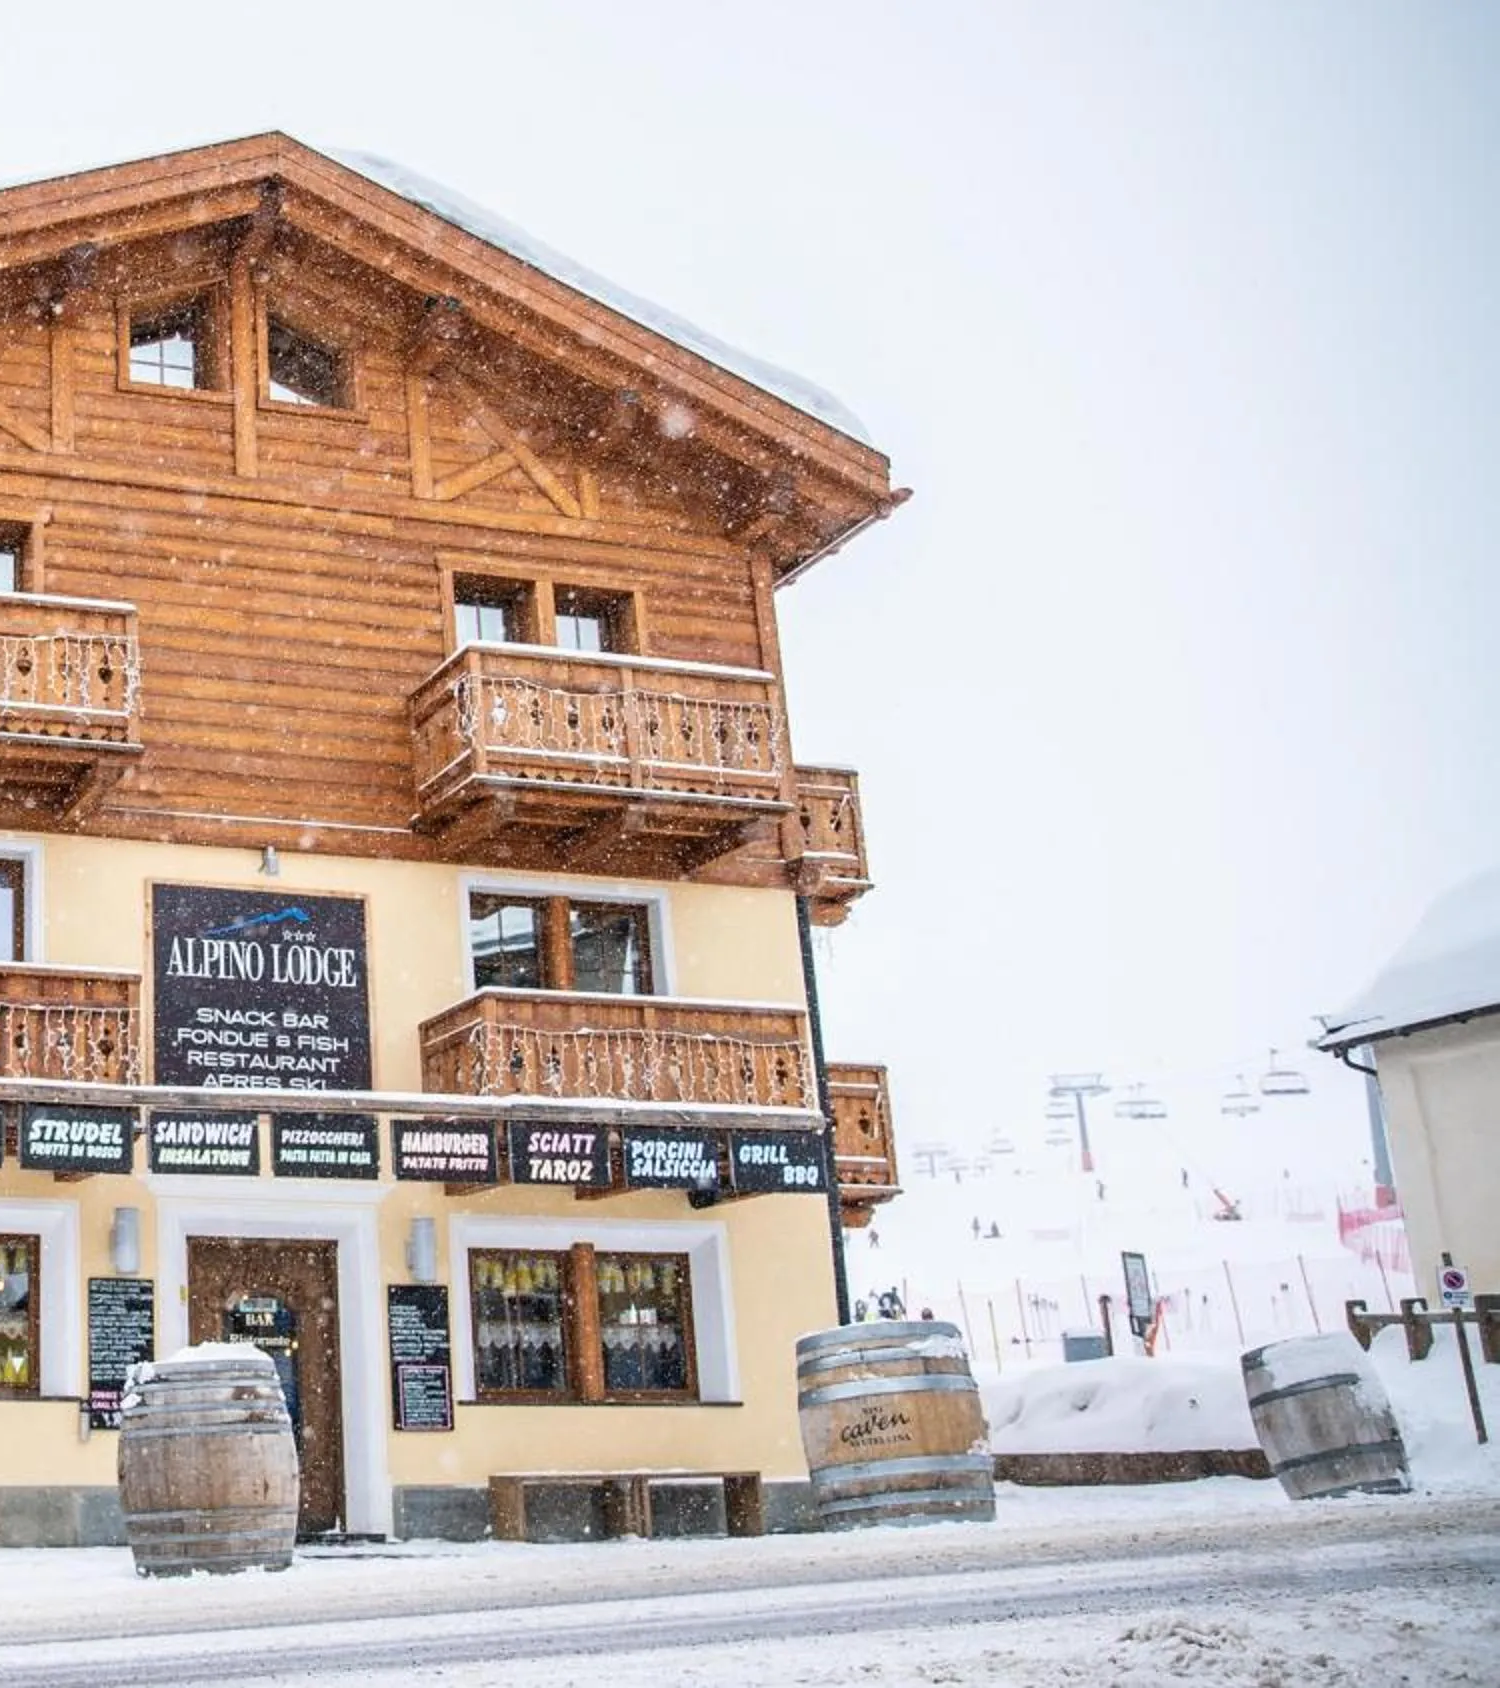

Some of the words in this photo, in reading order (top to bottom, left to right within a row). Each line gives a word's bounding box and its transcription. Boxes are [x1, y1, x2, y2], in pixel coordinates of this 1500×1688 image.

[166, 936, 264, 981] ALPINO
[271, 943, 357, 988] LODGE
[196, 1007, 276, 1027] SNACK
[283, 1012, 329, 1030] BAR
[177, 1028, 269, 1047] FONDUE
[297, 1036, 349, 1053] FISH
[187, 1052, 341, 1073] RESTAURANT
[289, 1077, 327, 1091] SKI
[28, 1119, 124, 1145] STRUDEL
[154, 1120, 253, 1146] SANDWICH
[281, 1129, 366, 1147] PIZZOCCHERI
[527, 1131, 596, 1154] SCIATT
[29, 1141, 69, 1157] FRUTTI
[87, 1145, 123, 1160] BOSCO
[401, 1131, 489, 1157] HAMBURGER
[630, 1140, 704, 1160] PORCINI
[739, 1144, 789, 1165] GRILL
[158, 1147, 252, 1167] INSALATONE
[402, 1156, 447, 1170] PATATE
[449, 1157, 489, 1172] FRITTE
[529, 1158, 594, 1182] TAROZ
[631, 1158, 717, 1178] SALSICCIA
[783, 1165, 819, 1186] BBQ
[245, 1313, 274, 1327] BAR
